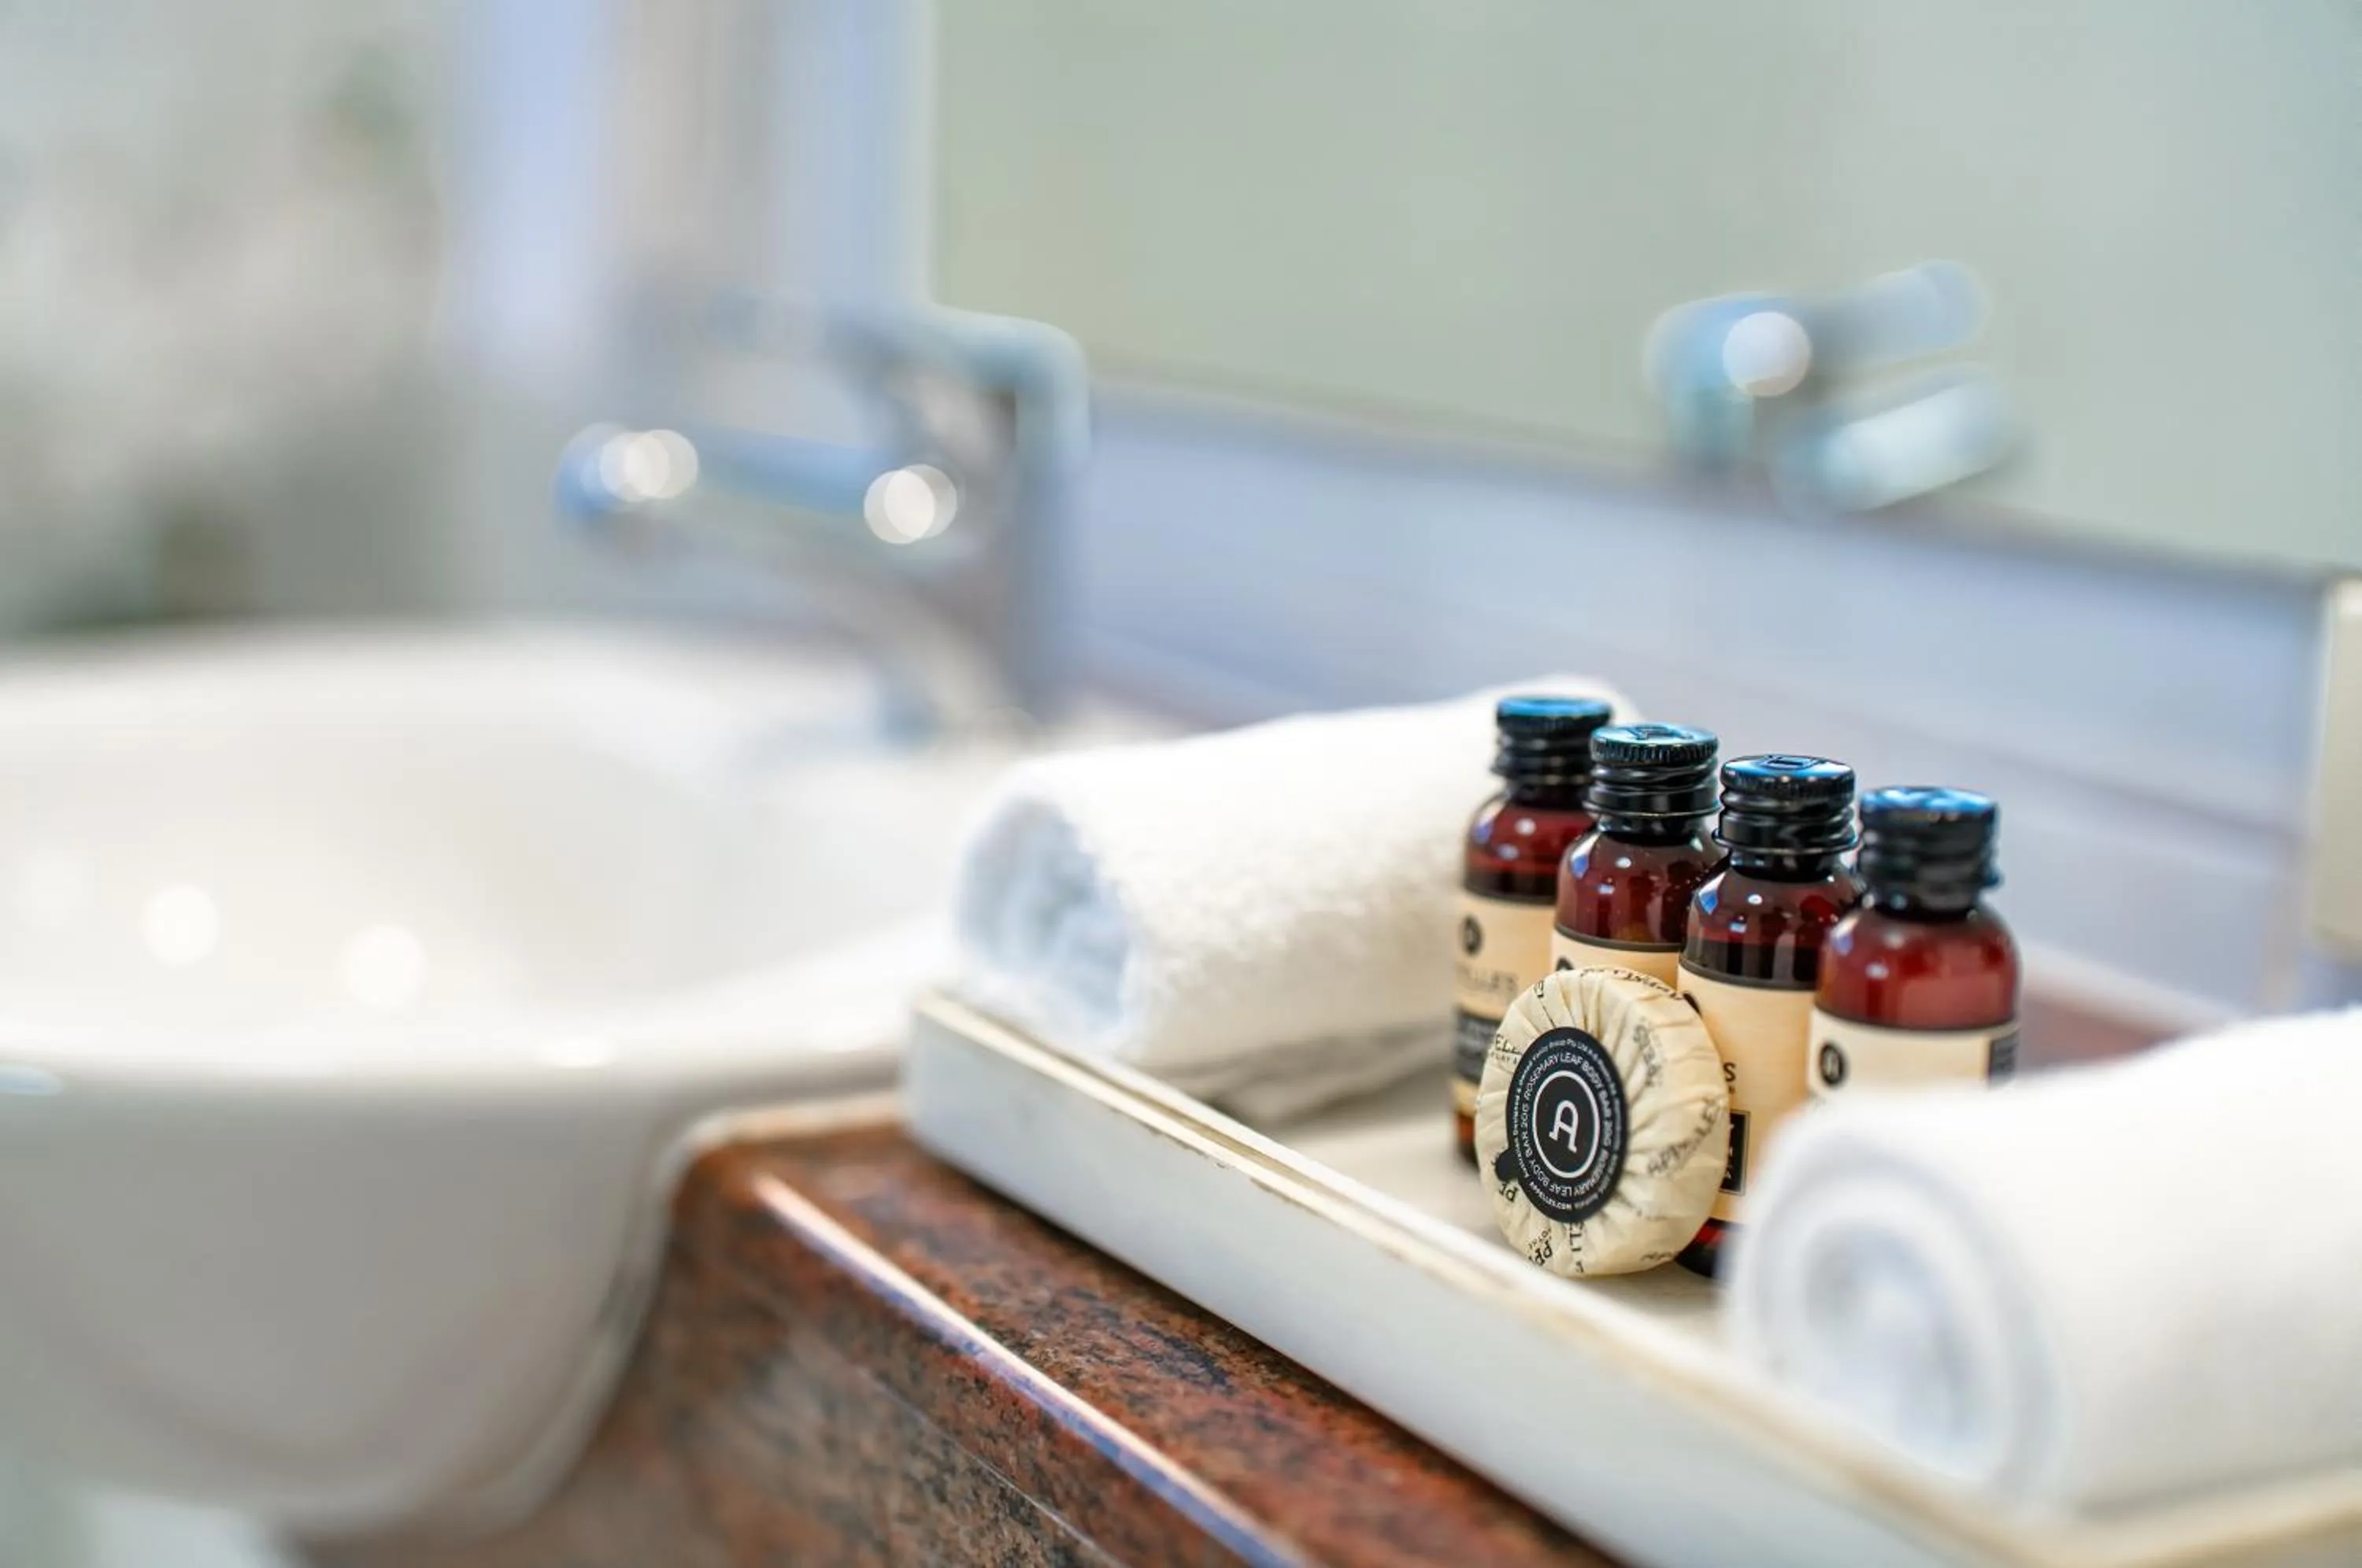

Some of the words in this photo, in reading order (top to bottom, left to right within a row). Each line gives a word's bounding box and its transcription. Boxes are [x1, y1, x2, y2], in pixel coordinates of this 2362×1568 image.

[1559, 1050, 1583, 1068] LEAF
[1549, 1100, 1578, 1154] A
[1549, 1180, 1572, 1197] LEAF
